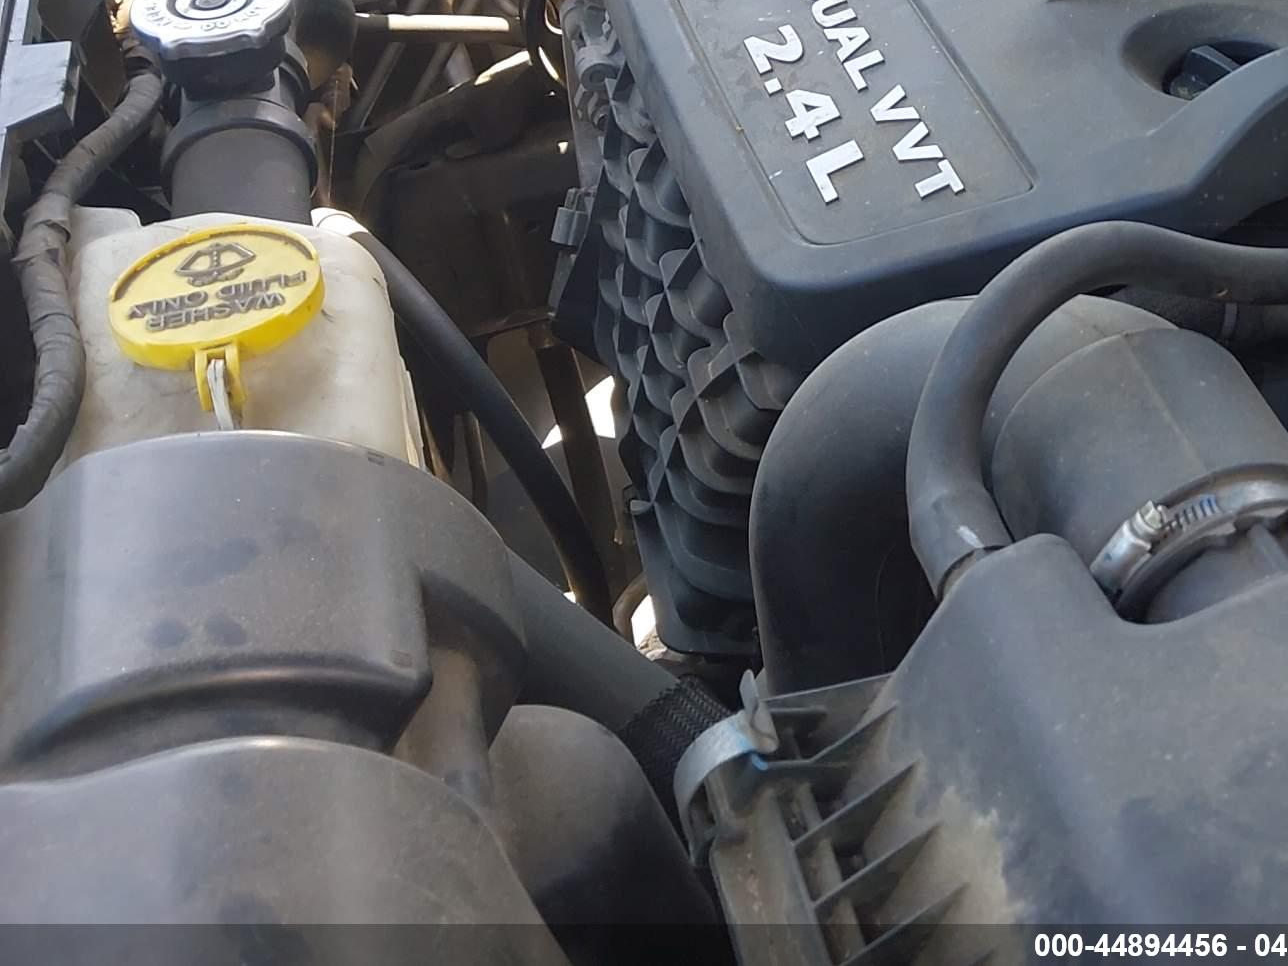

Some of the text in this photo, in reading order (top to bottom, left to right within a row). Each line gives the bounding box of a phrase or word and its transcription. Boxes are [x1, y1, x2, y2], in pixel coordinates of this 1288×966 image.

[870, 84, 965, 199] VVT
[128, 270, 307, 320] FLUID ONLY
[145, 291, 286, 333] WASHER
